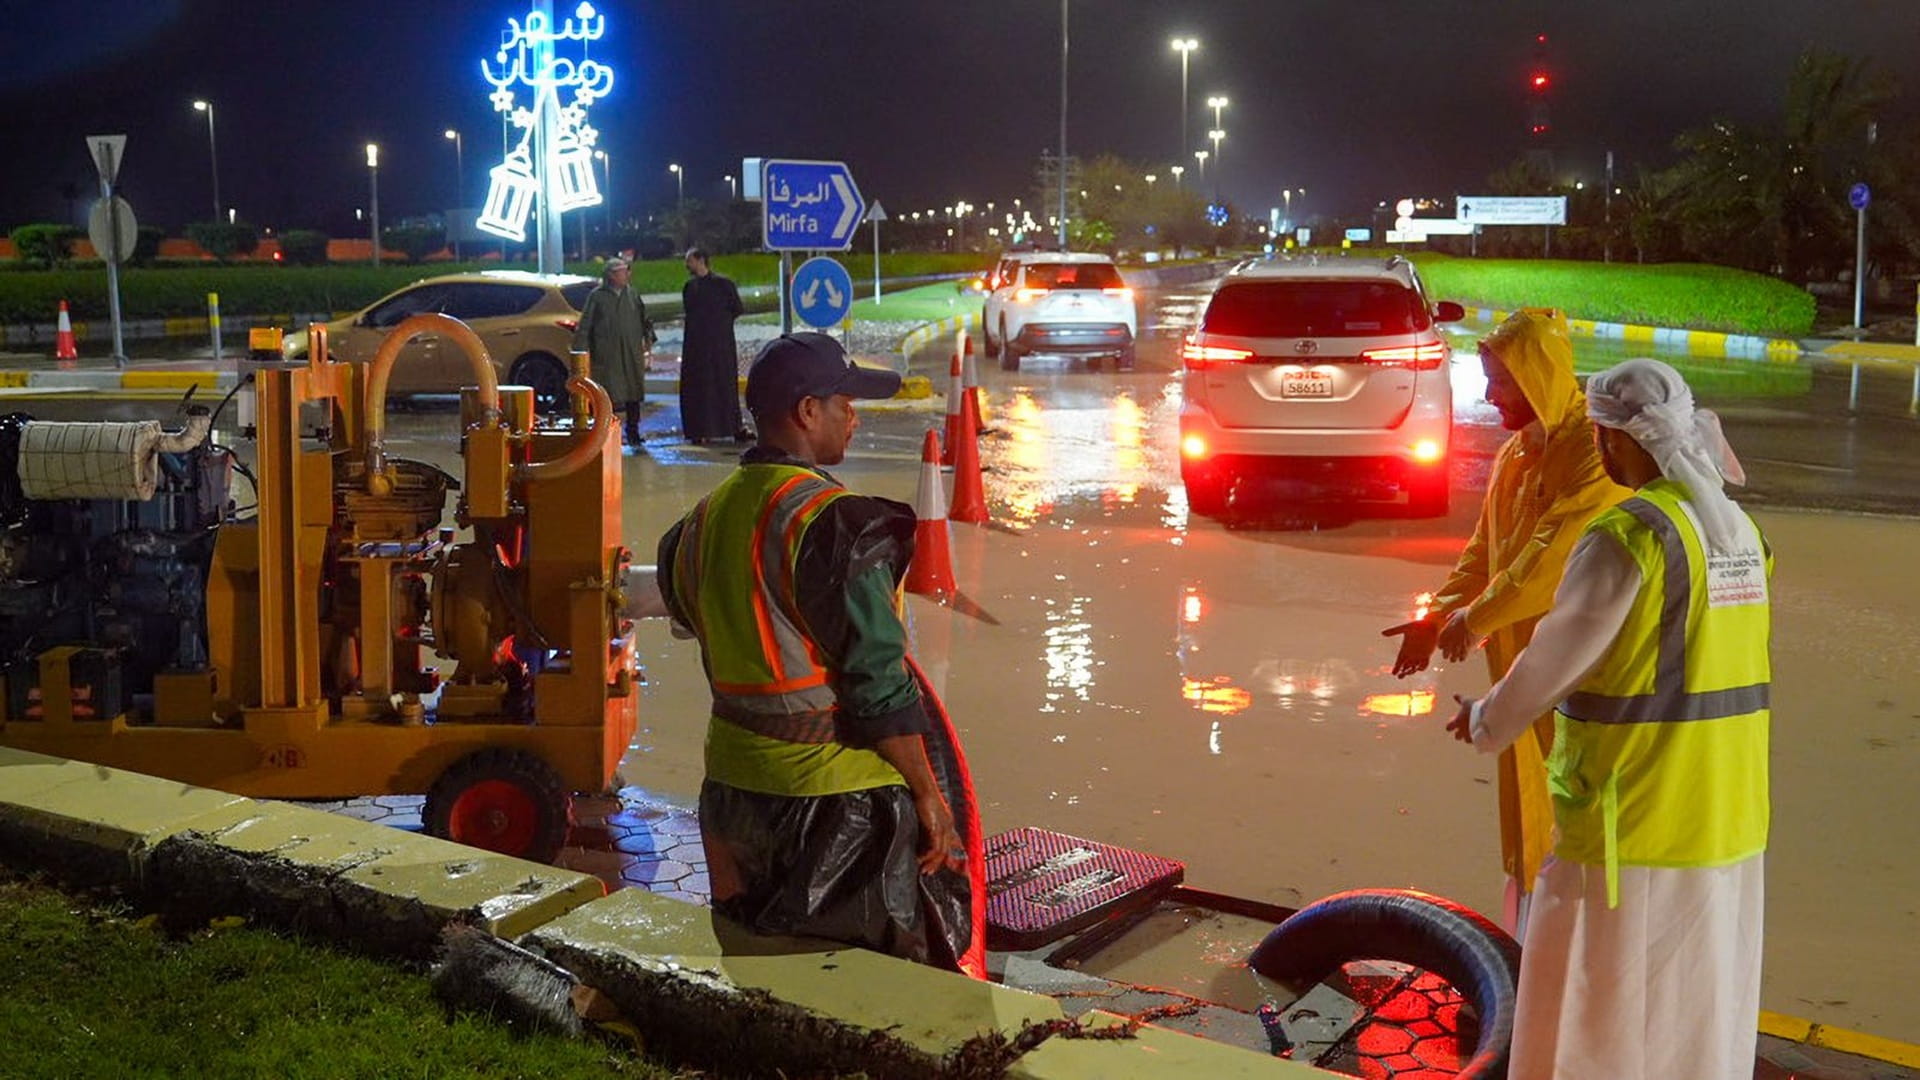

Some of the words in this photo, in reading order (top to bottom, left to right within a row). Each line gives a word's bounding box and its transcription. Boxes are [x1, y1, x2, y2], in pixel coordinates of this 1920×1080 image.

[500, 1, 605, 50] شهر
[480, 40, 614, 98] رمضان
[769, 174, 830, 208] المرفأ
[769, 213, 818, 233] Mirfa
[1288, 382, 1325, 394] 58611
